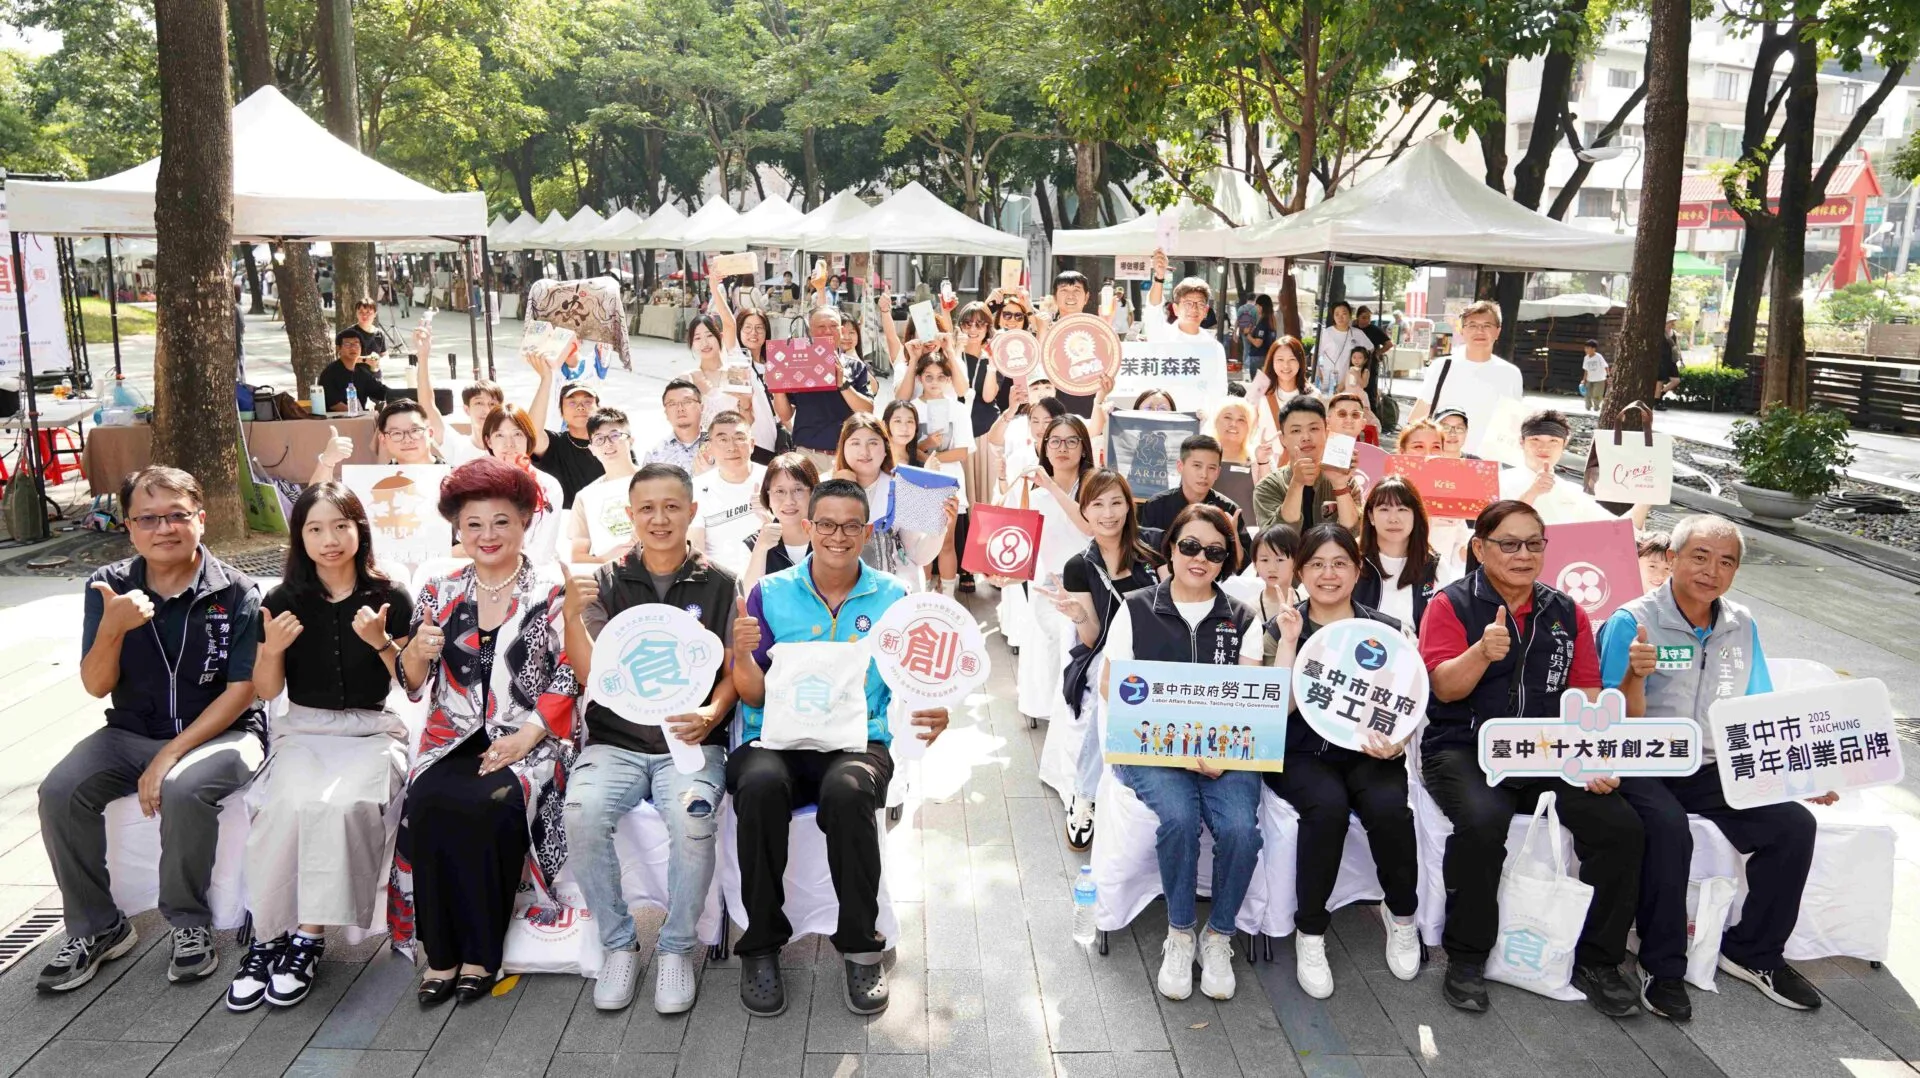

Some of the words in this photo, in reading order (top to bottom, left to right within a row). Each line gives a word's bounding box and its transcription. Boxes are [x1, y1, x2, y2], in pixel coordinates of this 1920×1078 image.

[1120, 357, 1200, 376] 茉莉森森
[726, 509, 733, 518] LE
[219, 623, 230, 659] 勞工局
[882, 633, 900, 652] 新
[900, 622, 958, 680] 創
[1228, 637, 1239, 665] 勞工
[603, 673, 622, 693] 新
[621, 638, 690, 698] 食
[1302, 659, 1416, 716] 臺中市政府
[1304, 681, 1397, 736] 勞工局
[1808, 711, 1831, 723] 2025
[1725, 715, 1801, 752] 臺中市
[1811, 719, 1861, 735] TAICHUNG
[1491, 739, 1689, 758] 臺中十大新創之星
[1730, 731, 1891, 781] 青年創業品牌
[1502, 928, 1548, 972] 食
